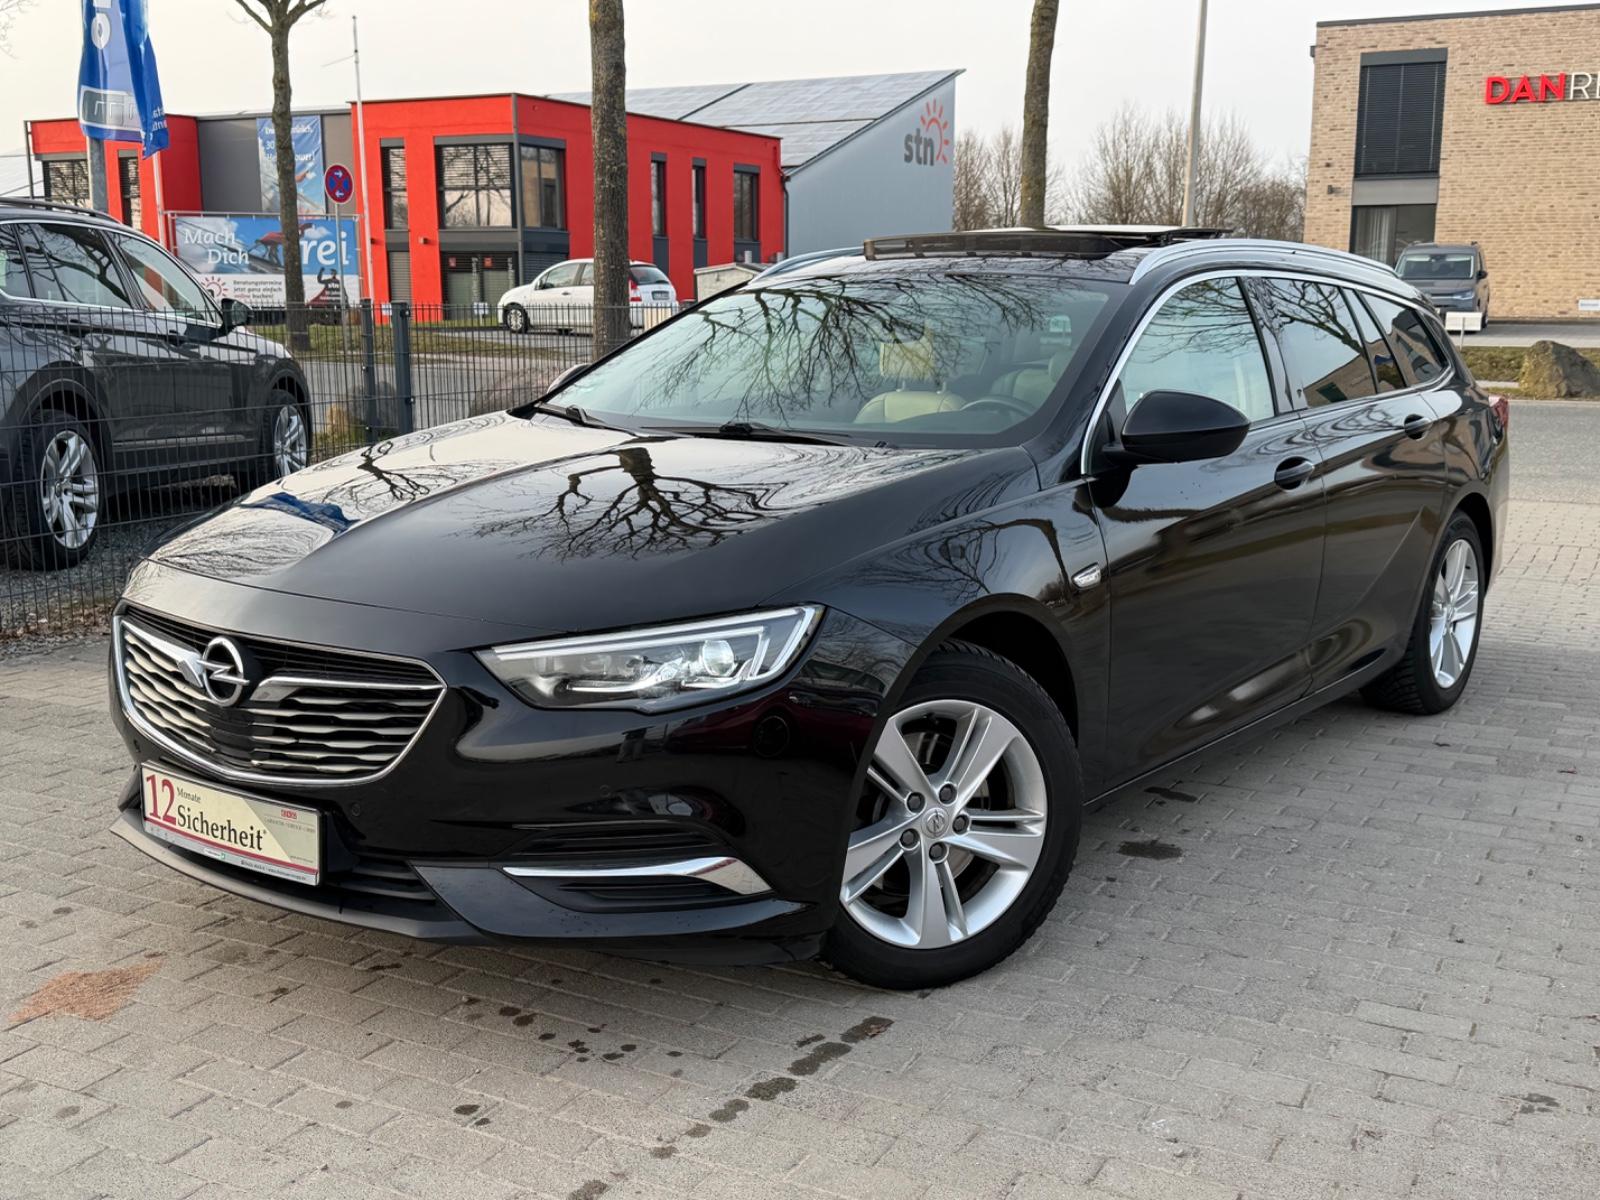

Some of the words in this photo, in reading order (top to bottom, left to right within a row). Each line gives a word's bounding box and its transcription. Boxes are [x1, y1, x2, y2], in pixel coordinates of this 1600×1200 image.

[904, 128, 934, 166] stn
[184, 229, 236, 245] Mach
[299, 231, 350, 265] rei
[207, 249, 250, 265] Dich
[146, 774, 177, 825] 12
[176, 786, 202, 802] Monate
